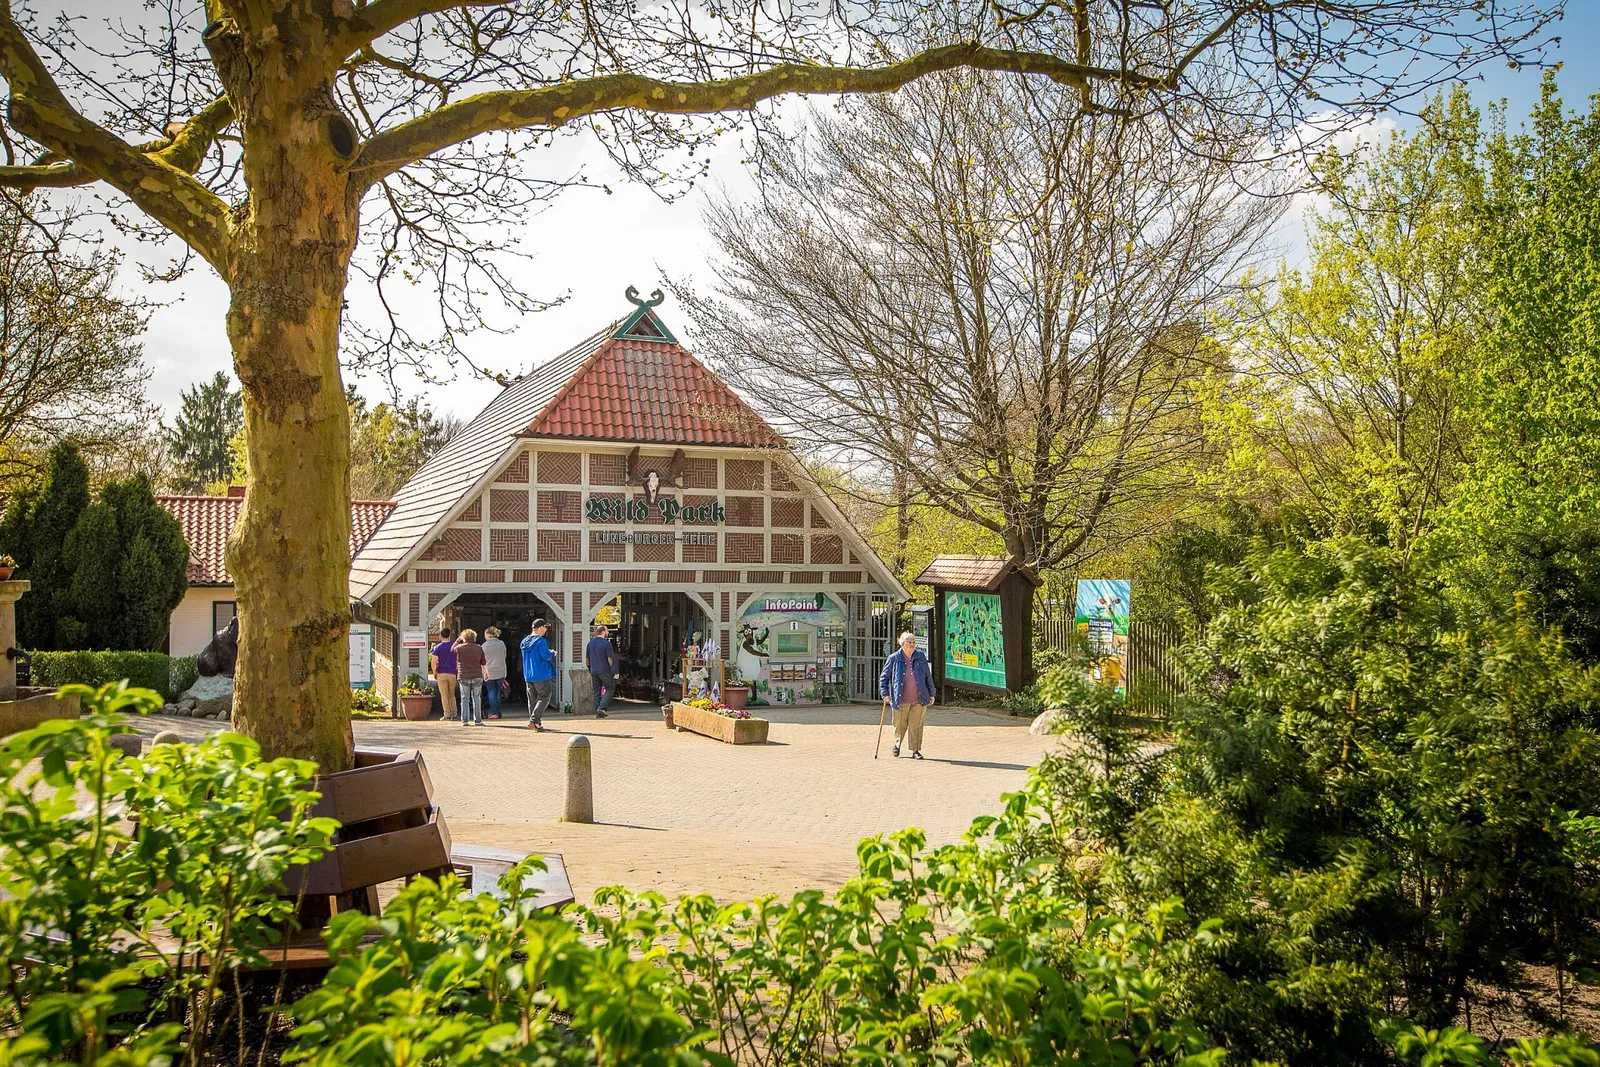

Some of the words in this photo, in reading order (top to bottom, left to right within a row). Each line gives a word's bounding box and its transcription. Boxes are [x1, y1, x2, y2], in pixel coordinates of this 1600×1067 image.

[585, 497, 649, 521] Wild
[658, 498, 726, 524] Park
[595, 530, 675, 545] LÜNEBURGER
[765, 599, 818, 610] InfoPoint
